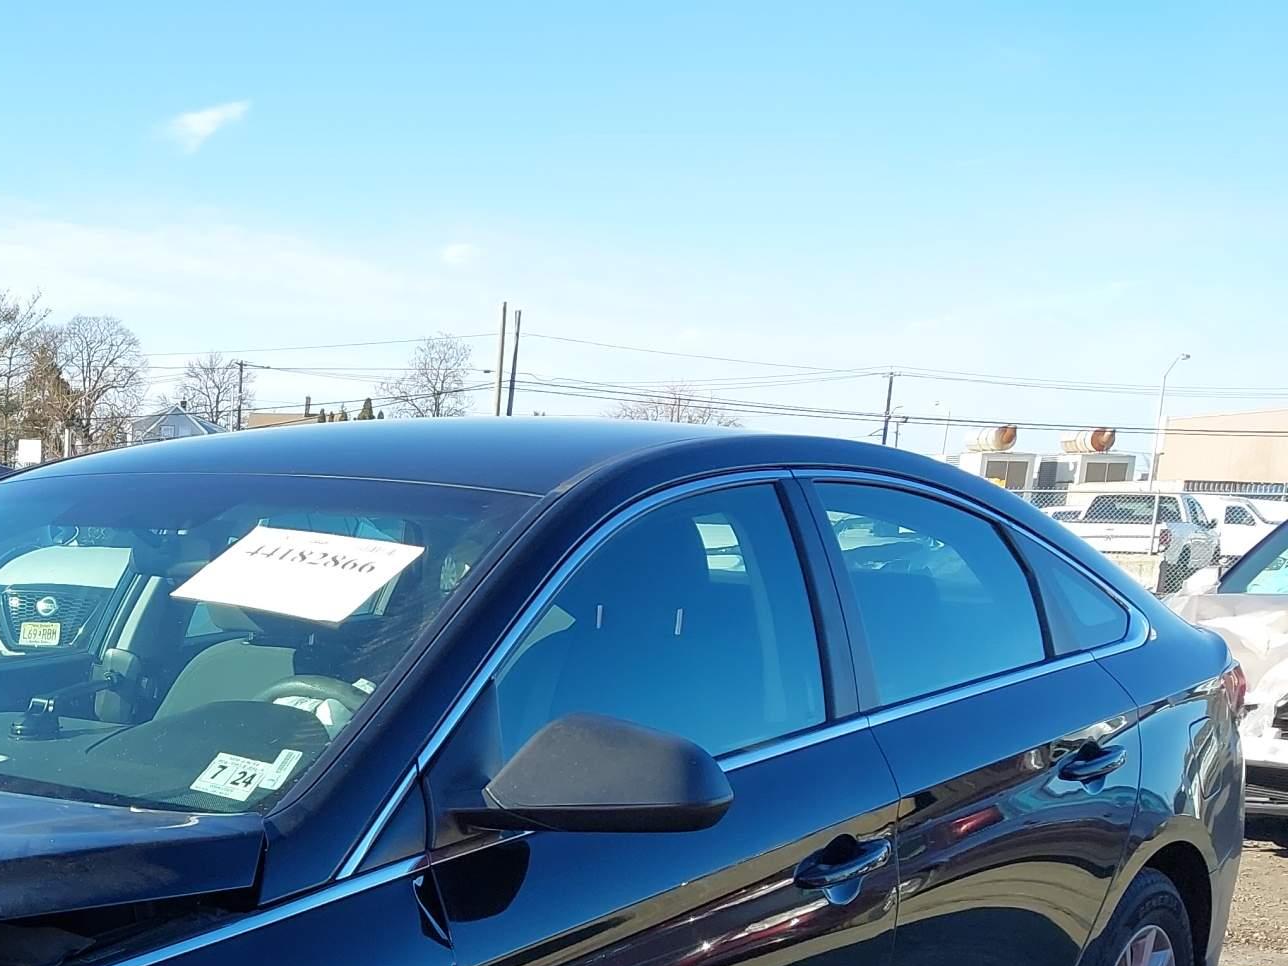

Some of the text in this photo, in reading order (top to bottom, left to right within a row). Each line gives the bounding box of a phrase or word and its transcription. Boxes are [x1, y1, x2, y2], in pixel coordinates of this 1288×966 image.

[246, 545, 375, 573] 44182866
[211, 765, 256, 787] 7 24
